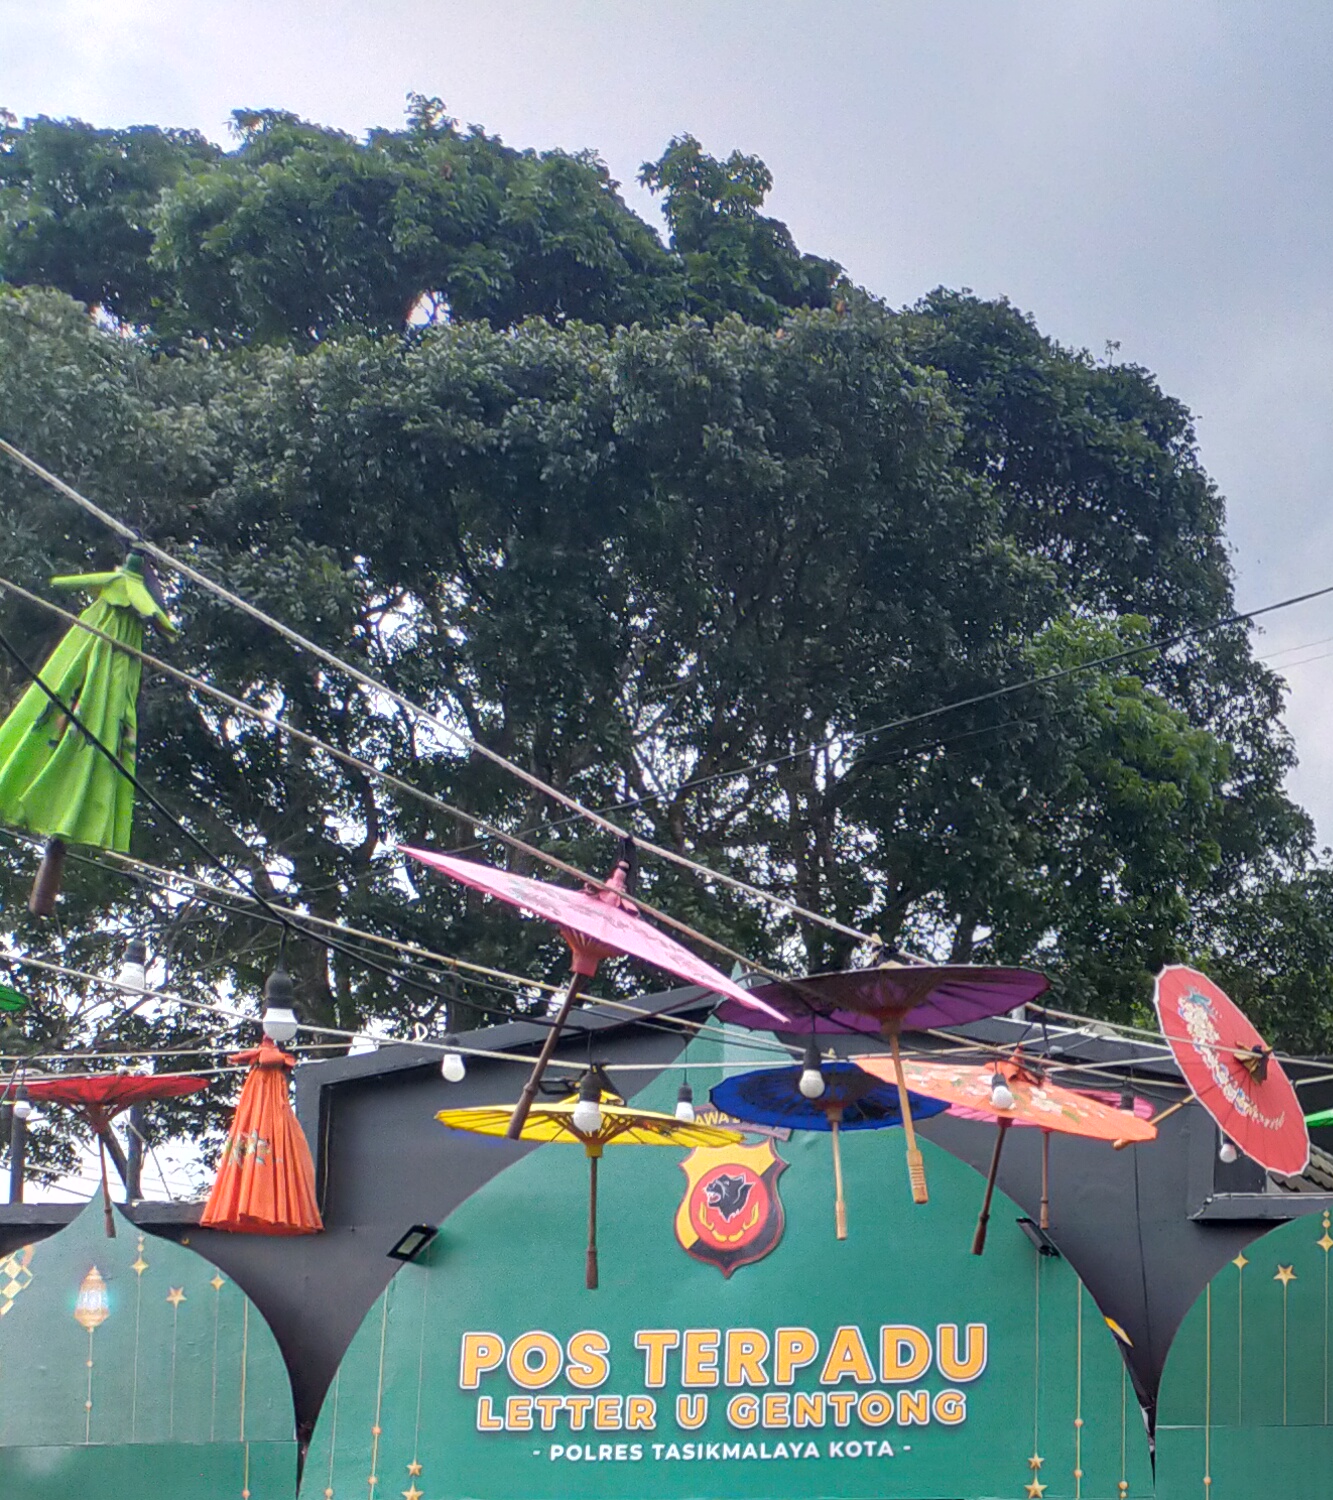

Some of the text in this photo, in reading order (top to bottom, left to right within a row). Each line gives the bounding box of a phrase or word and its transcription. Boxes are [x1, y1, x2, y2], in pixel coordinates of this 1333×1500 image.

[695, 1111, 730, 1126] AWA
[459, 1323, 988, 1390] POS TERPADU
[476, 1388, 967, 1431] LETTER U GENTONG
[550, 1442, 644, 1462] POLRES
[652, 1441, 820, 1461] TASIKMALAYA
[828, 1440, 895, 1459] KOTA
